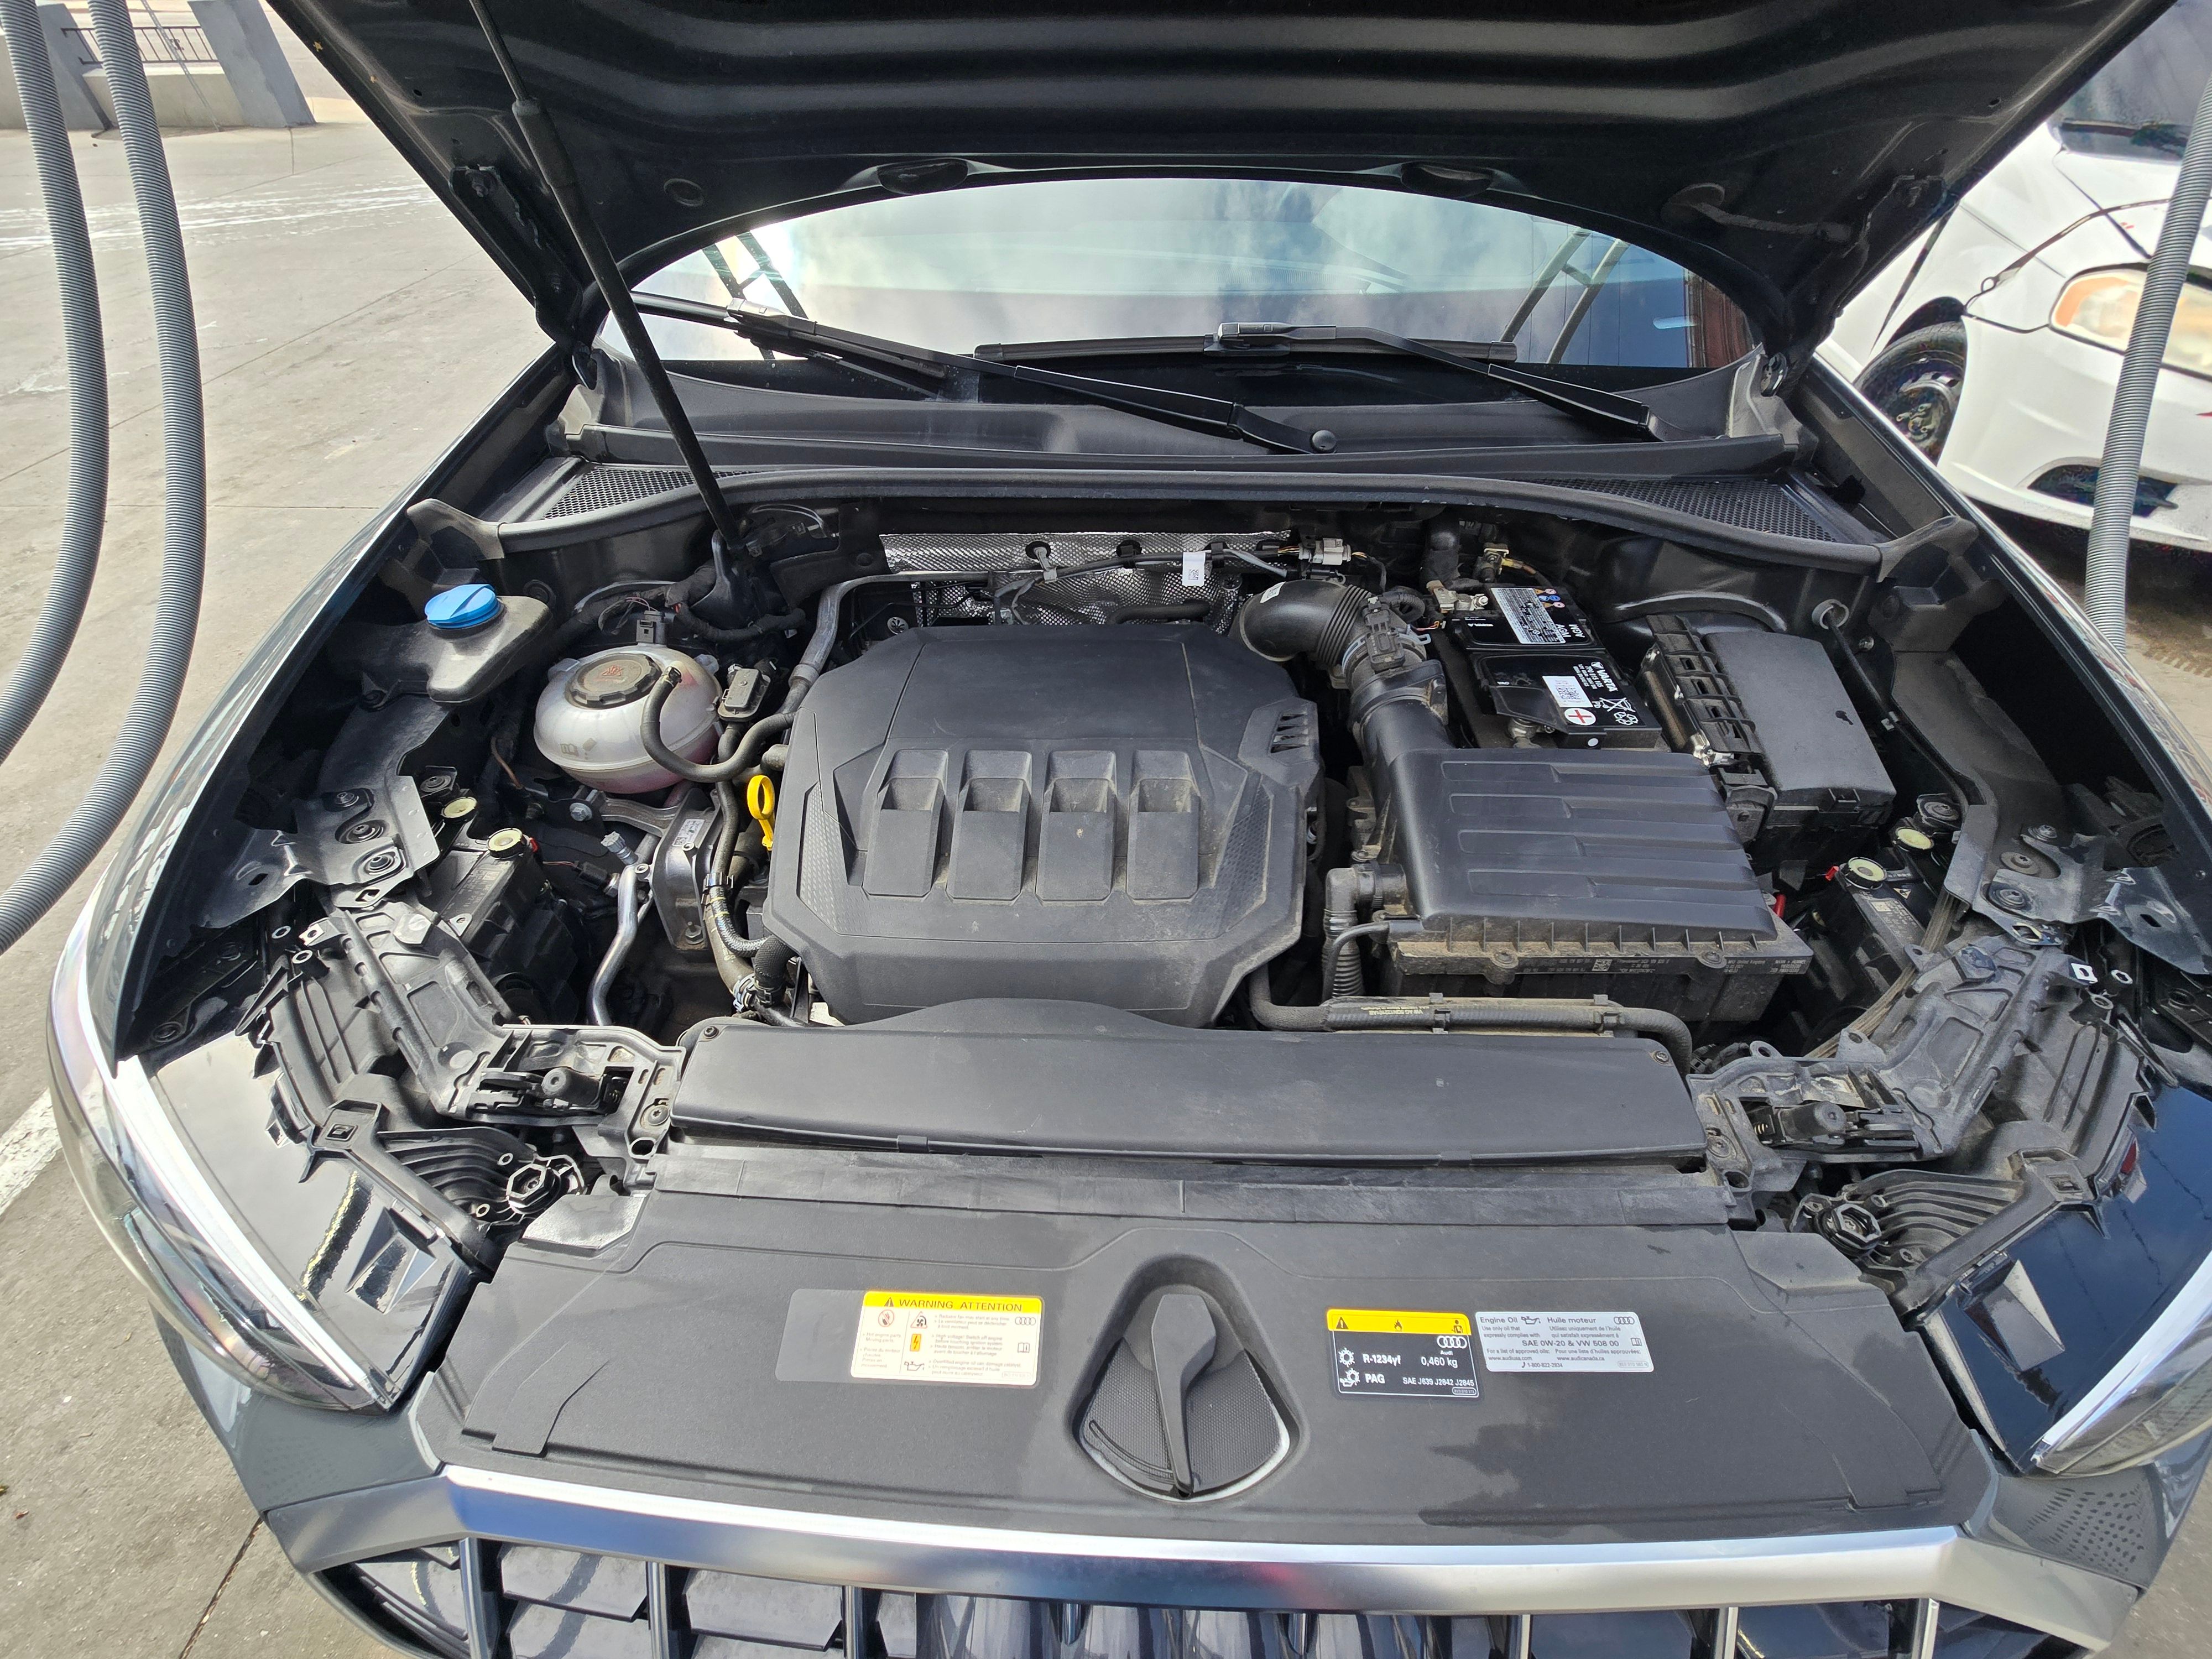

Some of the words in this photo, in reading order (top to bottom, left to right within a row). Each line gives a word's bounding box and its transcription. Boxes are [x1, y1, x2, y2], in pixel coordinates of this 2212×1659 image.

[1556, 624, 1571, 637] AGM
[1569, 624, 1585, 638] AGM
[1597, 669, 1618, 692] VARTA
[899, 1299, 953, 1309] WARNING
[960, 1301, 1022, 1312] ATTENTION
[1363, 1353, 1401, 1366] R-1234yf
[1421, 1356, 1445, 1367] 0,460
[1447, 1357, 1458, 1369] kg
[1365, 1374, 1385, 1384] PAG
[1402, 1376, 1416, 1385] SAE
